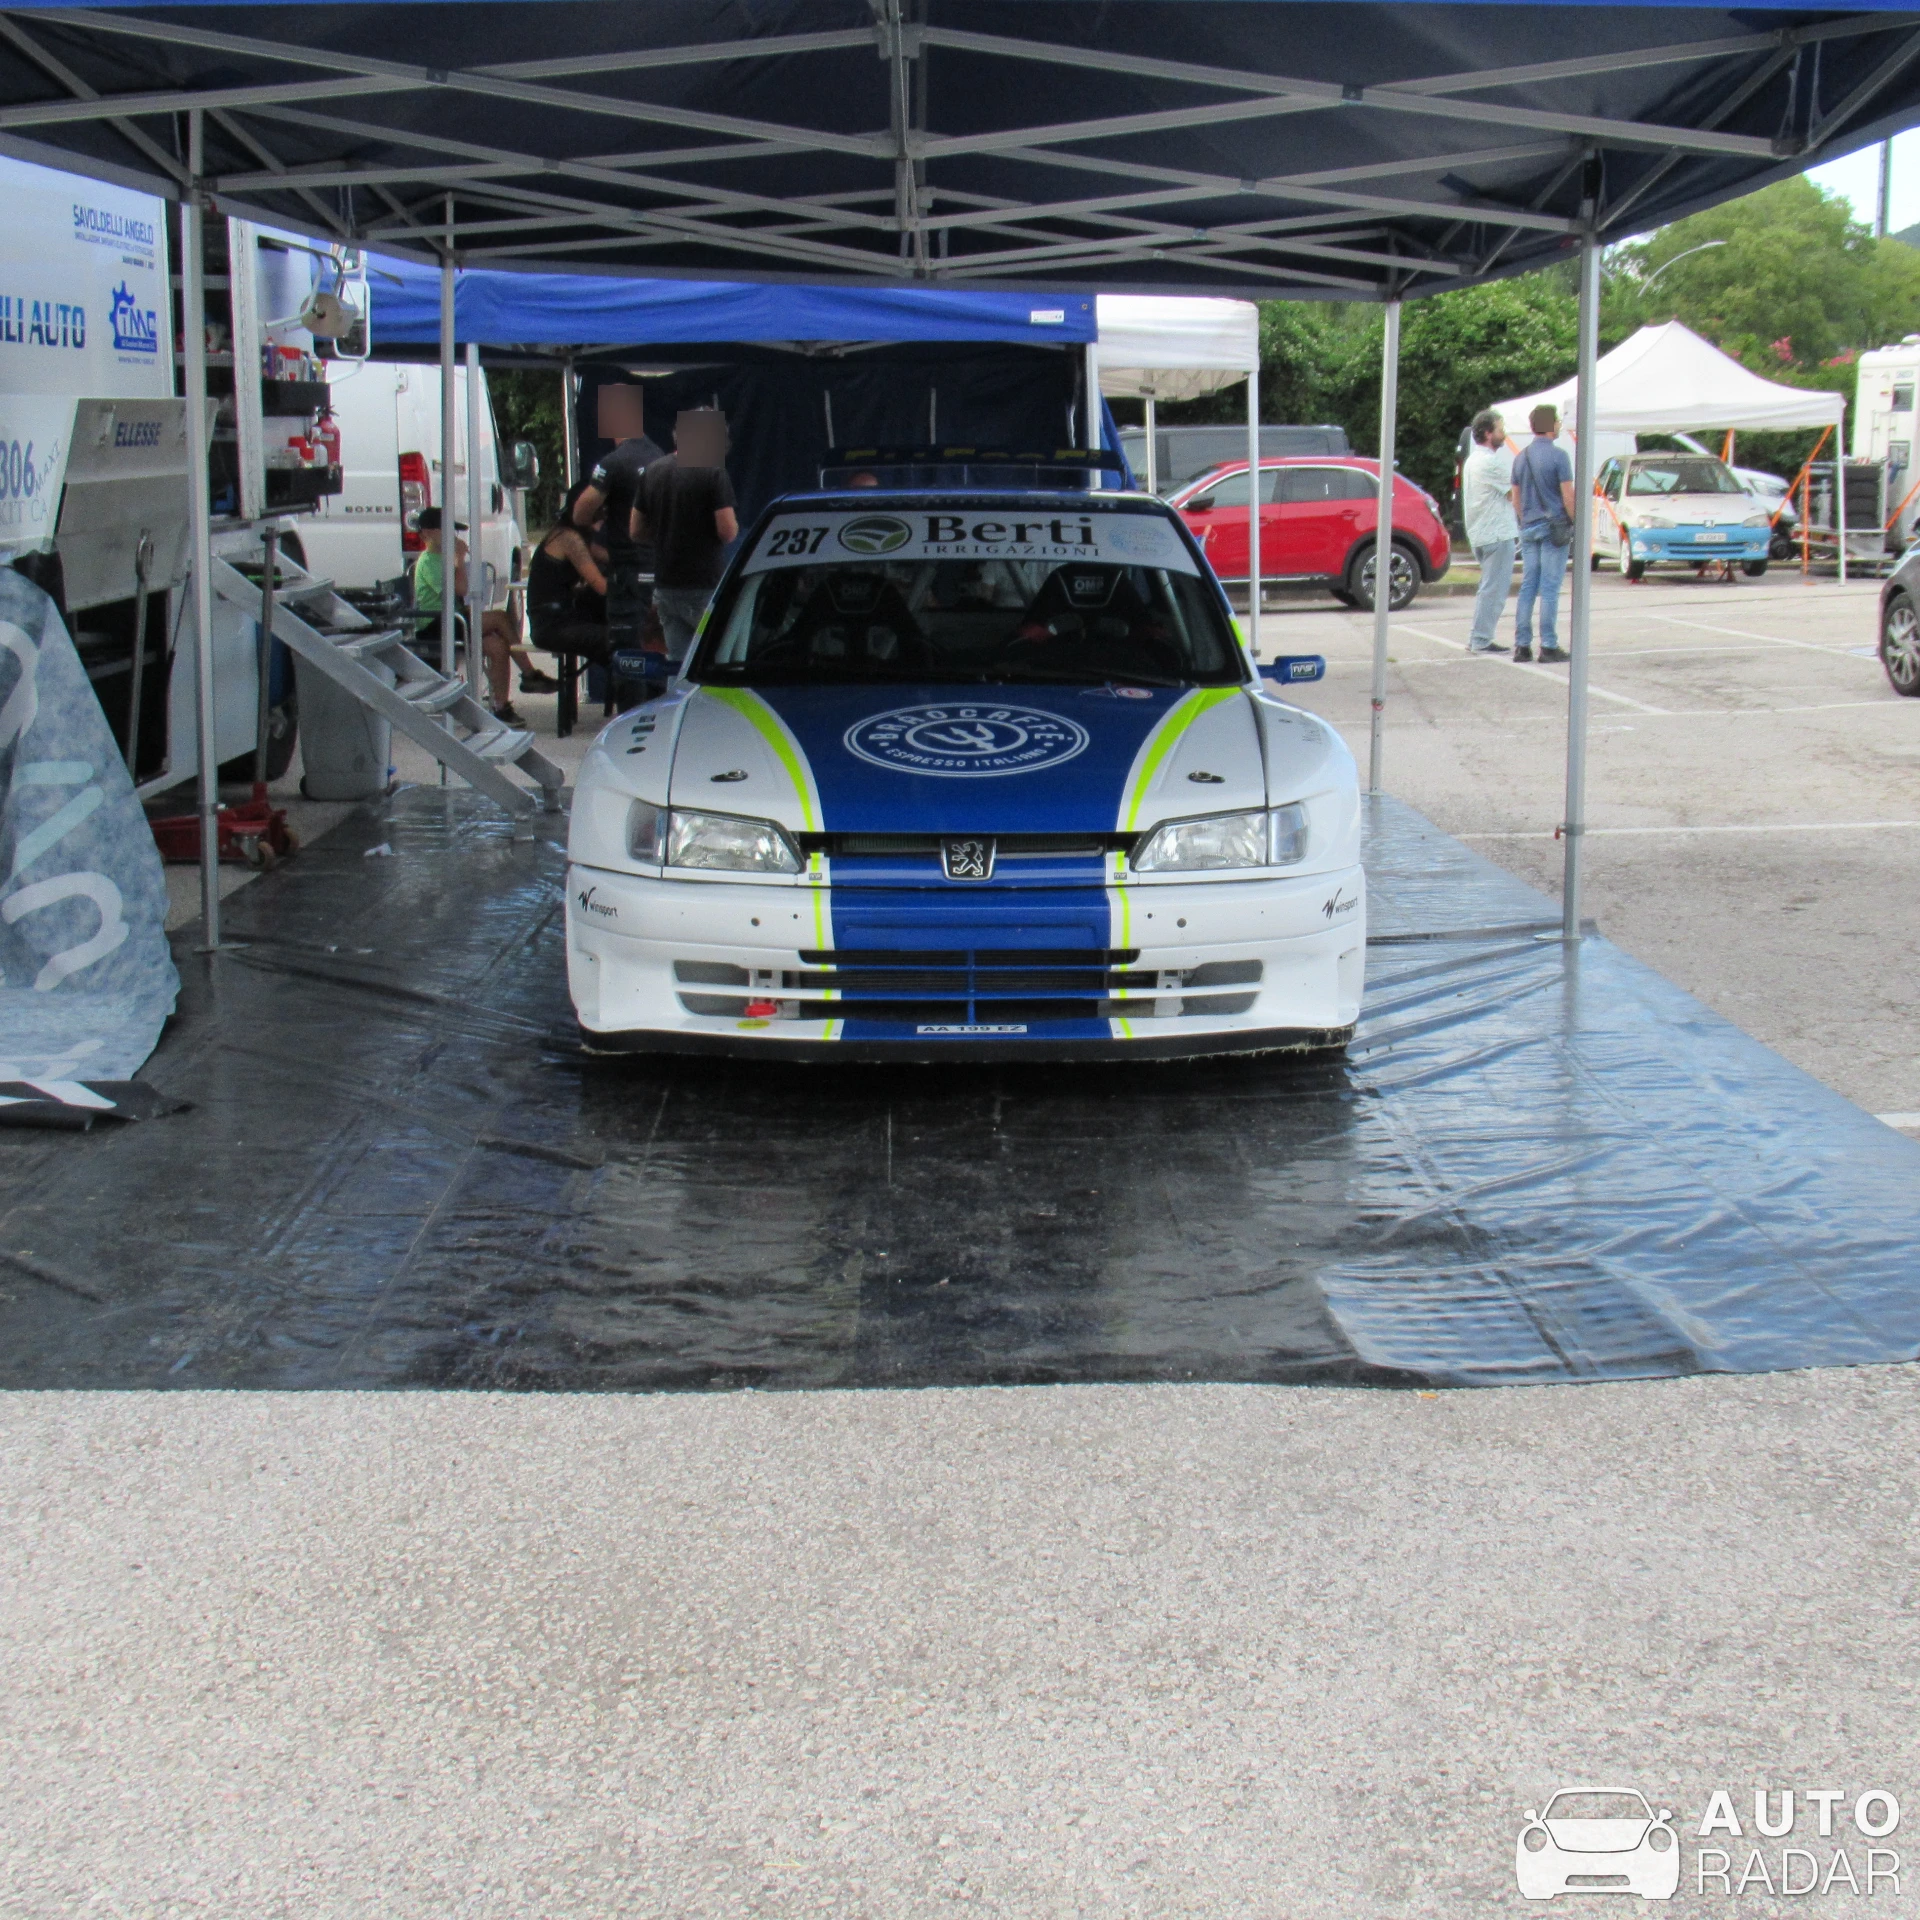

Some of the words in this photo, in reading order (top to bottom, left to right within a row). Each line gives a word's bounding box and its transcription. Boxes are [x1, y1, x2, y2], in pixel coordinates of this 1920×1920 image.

[73, 204, 123, 236] SAVOLDELLI
[125, 218, 154, 245] ANGELO
[29, 300, 86, 349] AUTO
[114, 422, 163, 447] ELLESSE
[345, 505, 393, 513] BOXER
[767, 527, 830, 557] 237
[921, 516, 1097, 546] Berti
[923, 545, 1100, 557] IRRIGAZIONI
[1074, 579, 1104, 591] OMP
[885, 747, 967, 767] ESPRESSO
[975, 748, 1048, 767] ITALIANO
